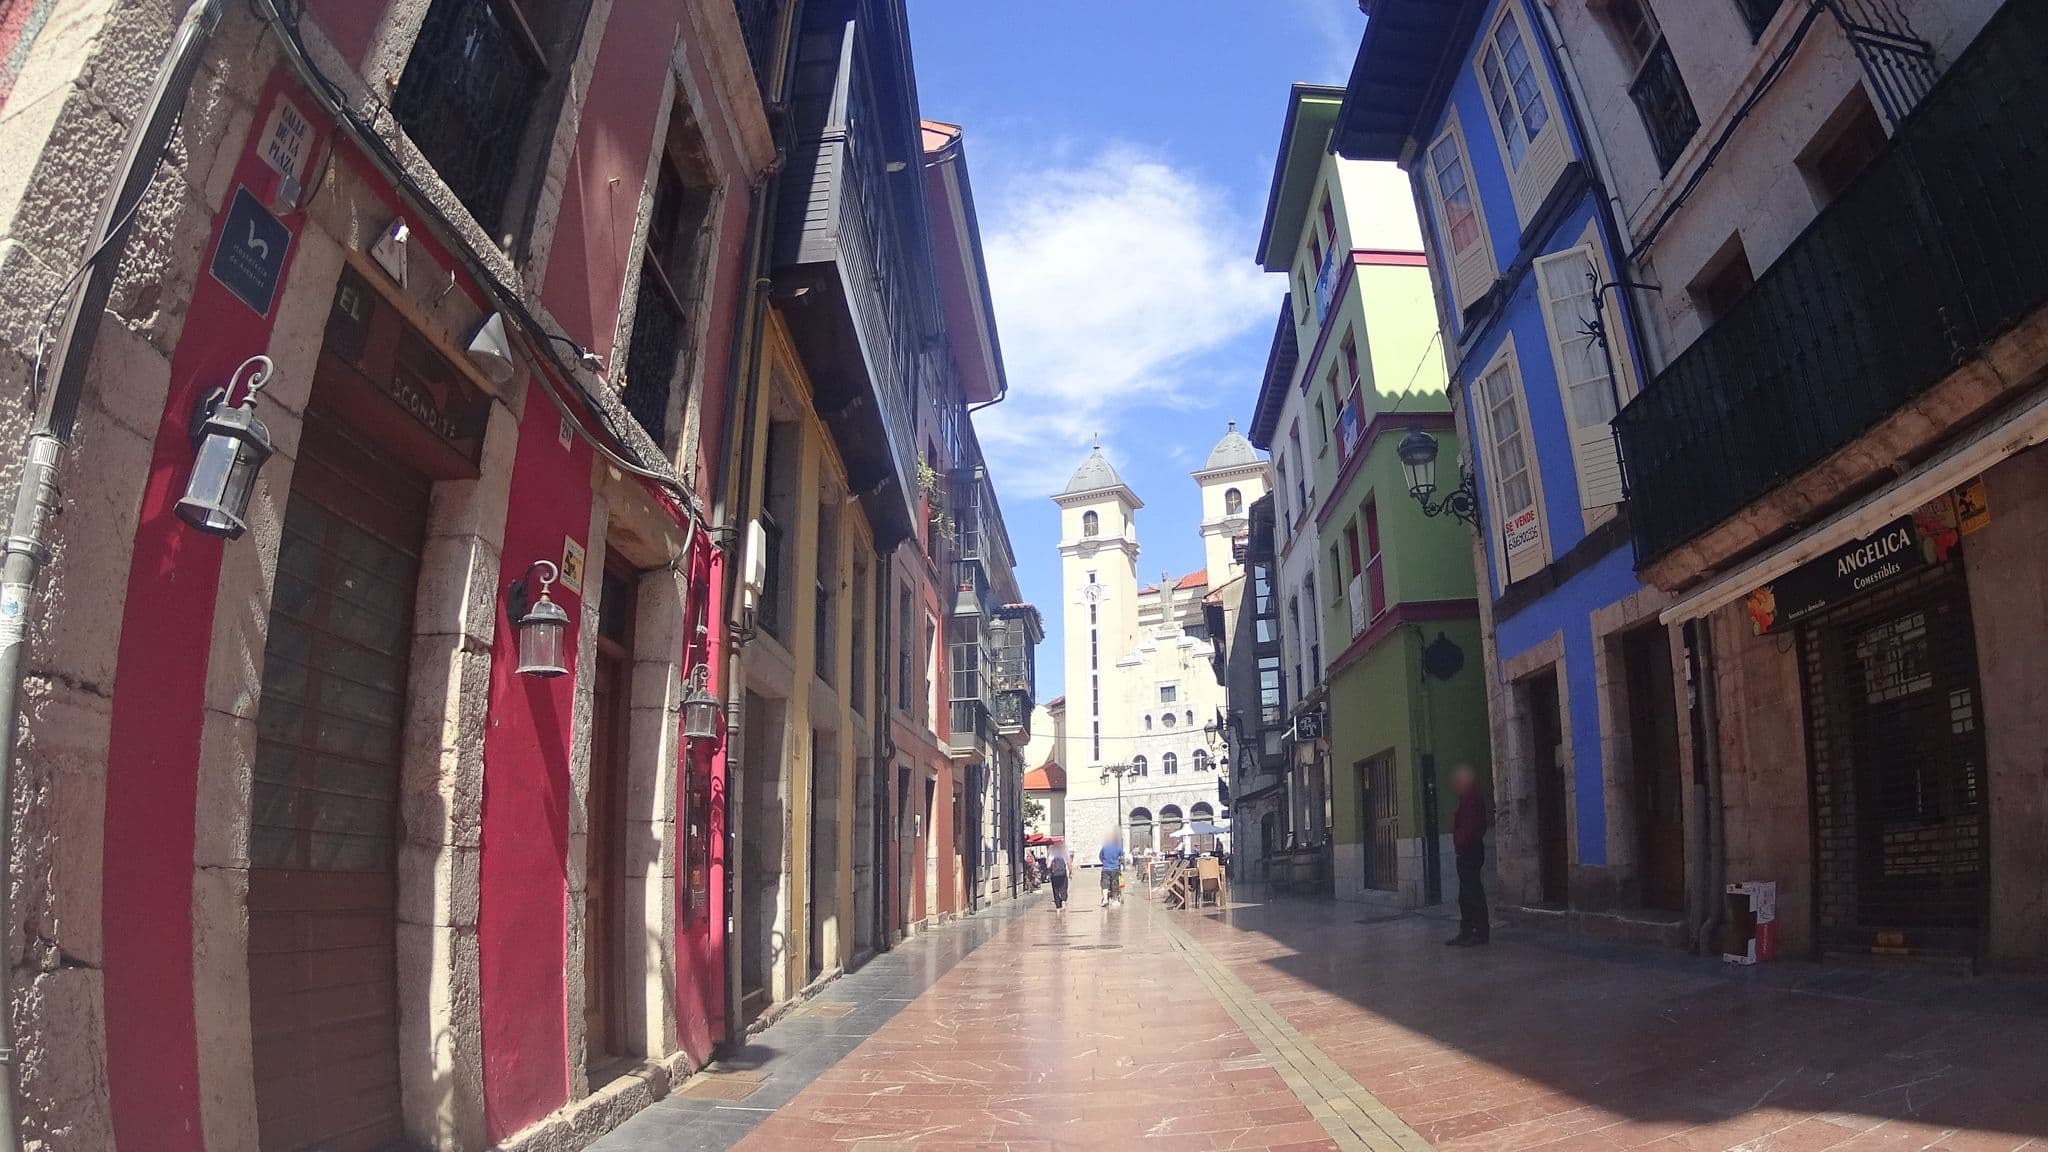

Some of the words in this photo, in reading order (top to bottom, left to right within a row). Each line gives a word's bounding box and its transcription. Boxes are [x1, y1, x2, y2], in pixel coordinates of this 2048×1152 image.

[275, 122, 289, 145] DE
[288, 135, 300, 157] LA
[281, 105, 306, 139] CALLE
[269, 140, 296, 177] PLAZA
[339, 287, 361, 322] EL
[1505, 521, 1514, 534] SE
[1514, 510, 1536, 529] VENDE
[1837, 528, 1911, 578] ANGELICA
